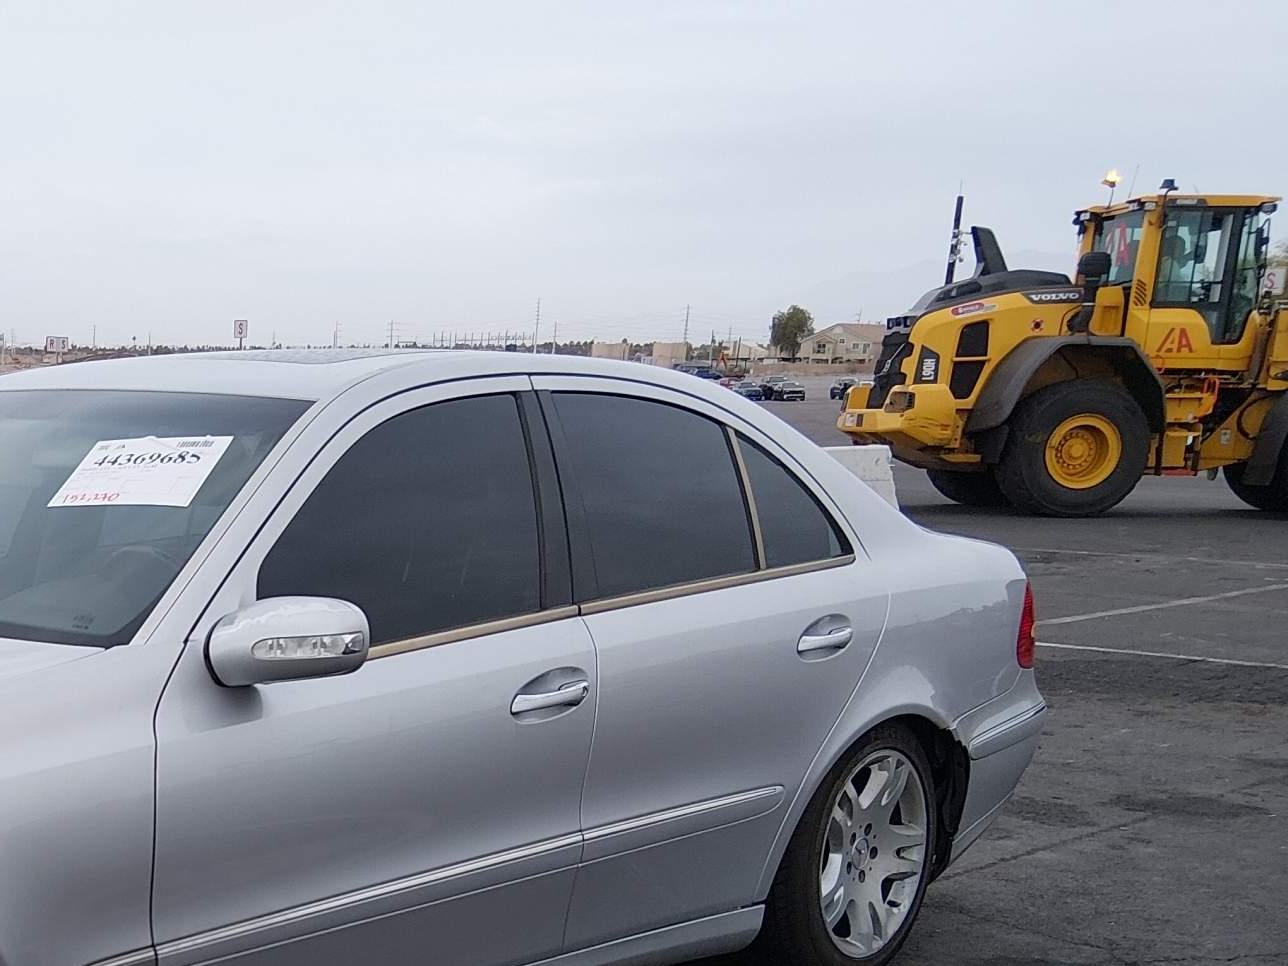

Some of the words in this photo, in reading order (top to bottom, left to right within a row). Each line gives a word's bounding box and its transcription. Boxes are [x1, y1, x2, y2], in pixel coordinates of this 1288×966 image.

[1264, 272, 1276, 289] S
[1028, 292, 1080, 302] VOLVO
[238, 322, 244, 336] S
[920, 358, 937, 381] L90H
[93, 450, 202, 467] 44369685
